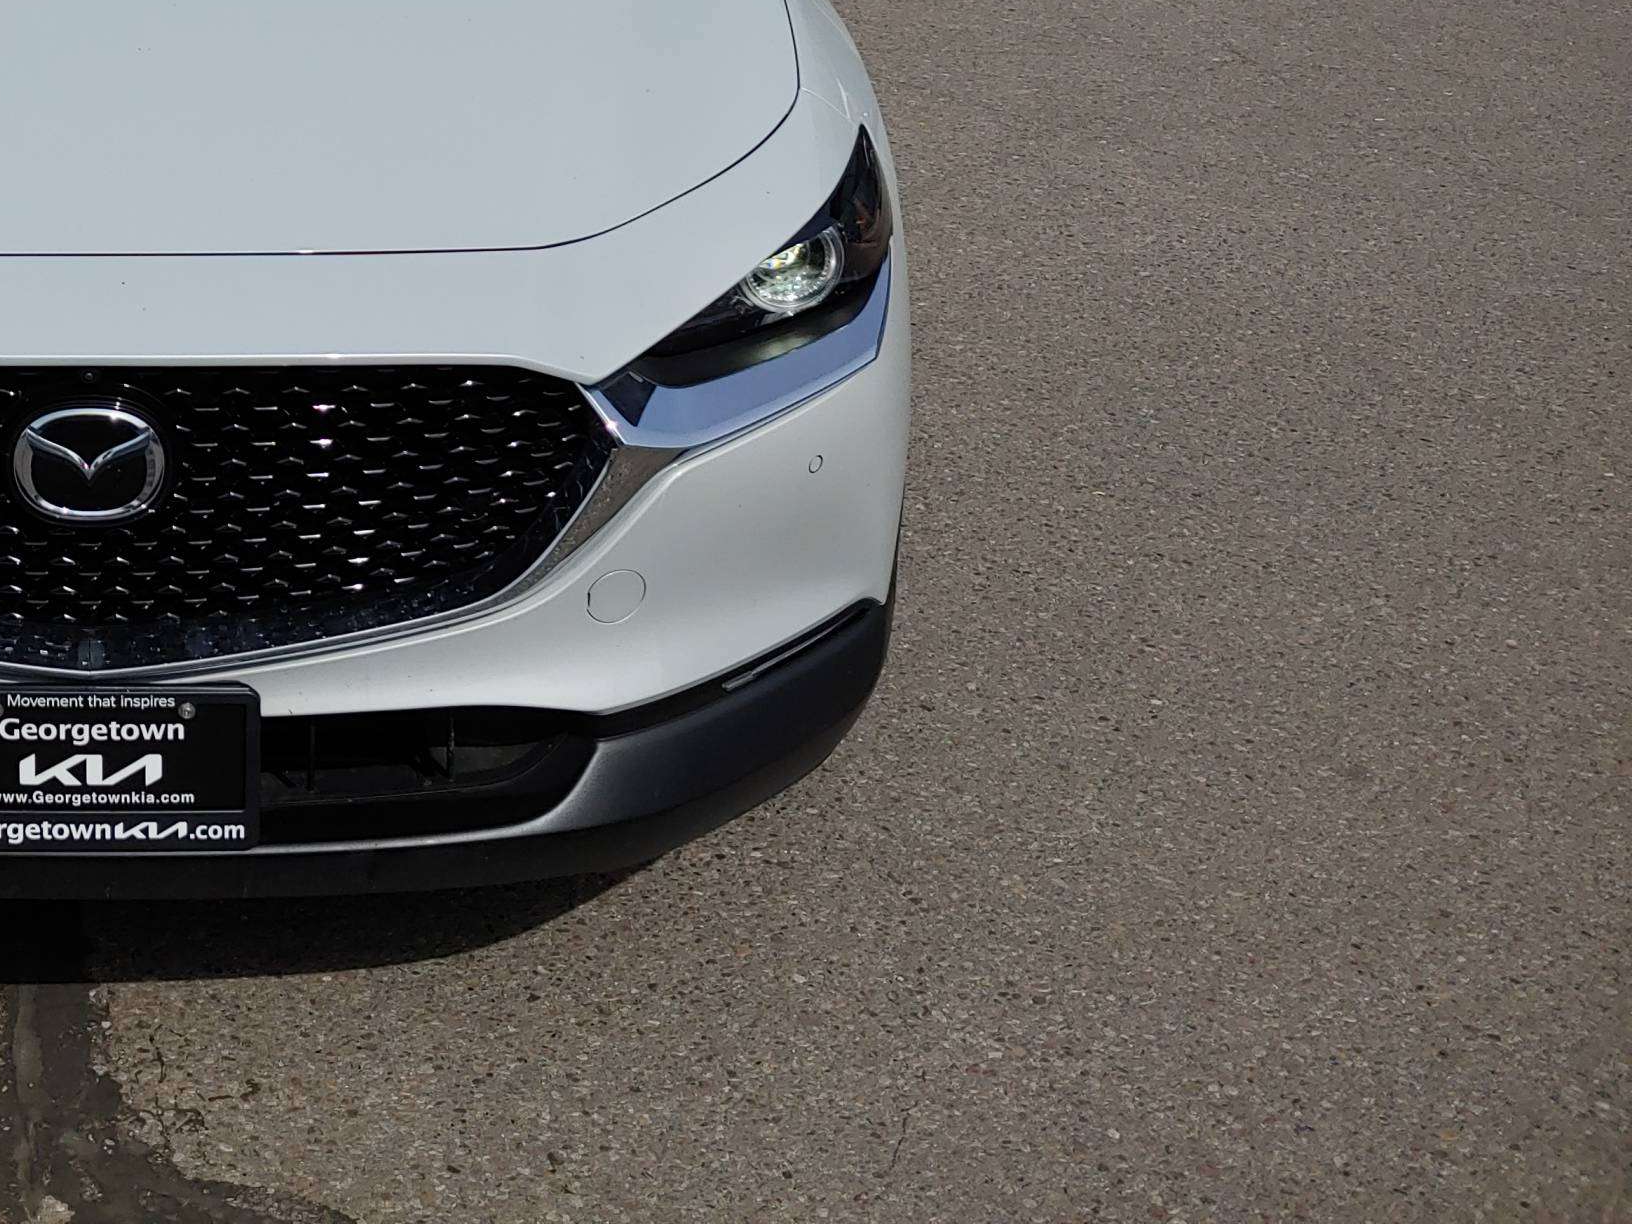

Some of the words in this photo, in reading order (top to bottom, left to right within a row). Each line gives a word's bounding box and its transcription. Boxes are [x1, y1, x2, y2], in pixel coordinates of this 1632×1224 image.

[7, 694, 84, 708] Movement
[87, 694, 117, 708] that
[120, 694, 176, 710] inspires
[19, 753, 163, 787] KIA
